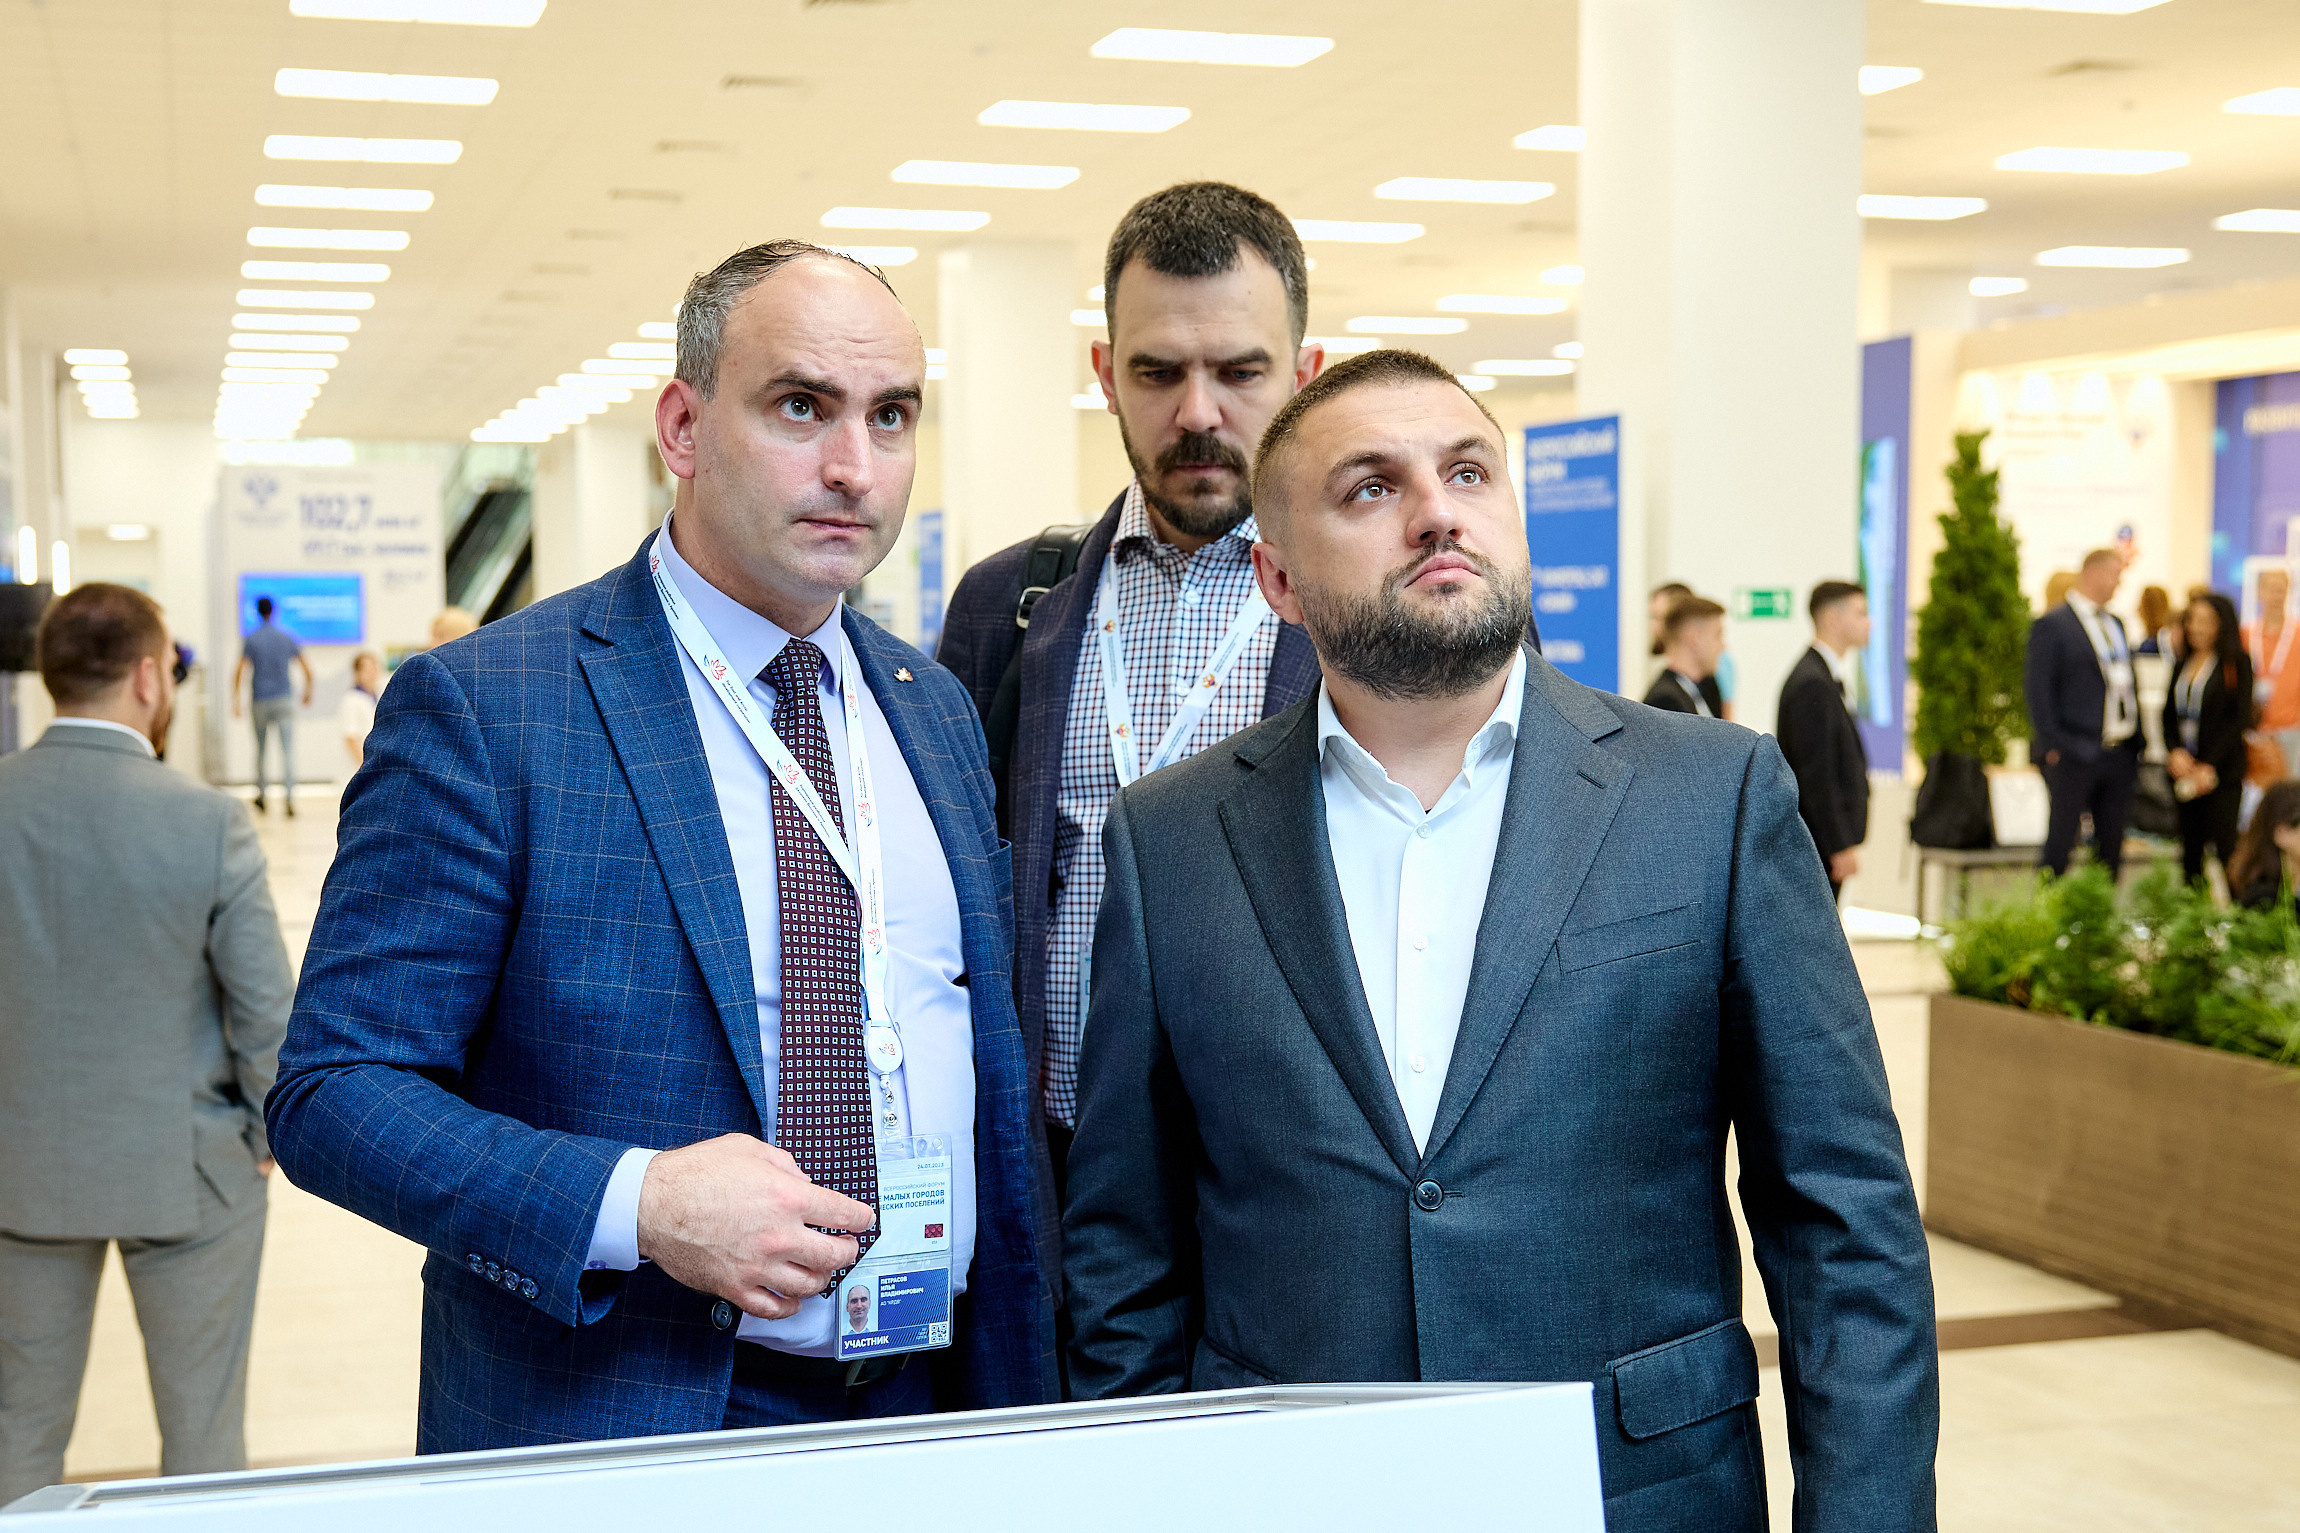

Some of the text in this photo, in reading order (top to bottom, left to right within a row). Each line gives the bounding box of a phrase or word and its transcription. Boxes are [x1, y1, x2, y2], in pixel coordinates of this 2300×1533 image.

[884, 1192, 910, 1201] МАЛЫХ
[912, 1190, 944, 1198] ГОРОДОВ
[905, 1198, 944, 1208] ПОСЕЛЕНИЙ
[880, 1287, 924, 1298] ВЛАДИМИРОВИЧ
[844, 1335, 889, 1349] УЧАСТНИК
